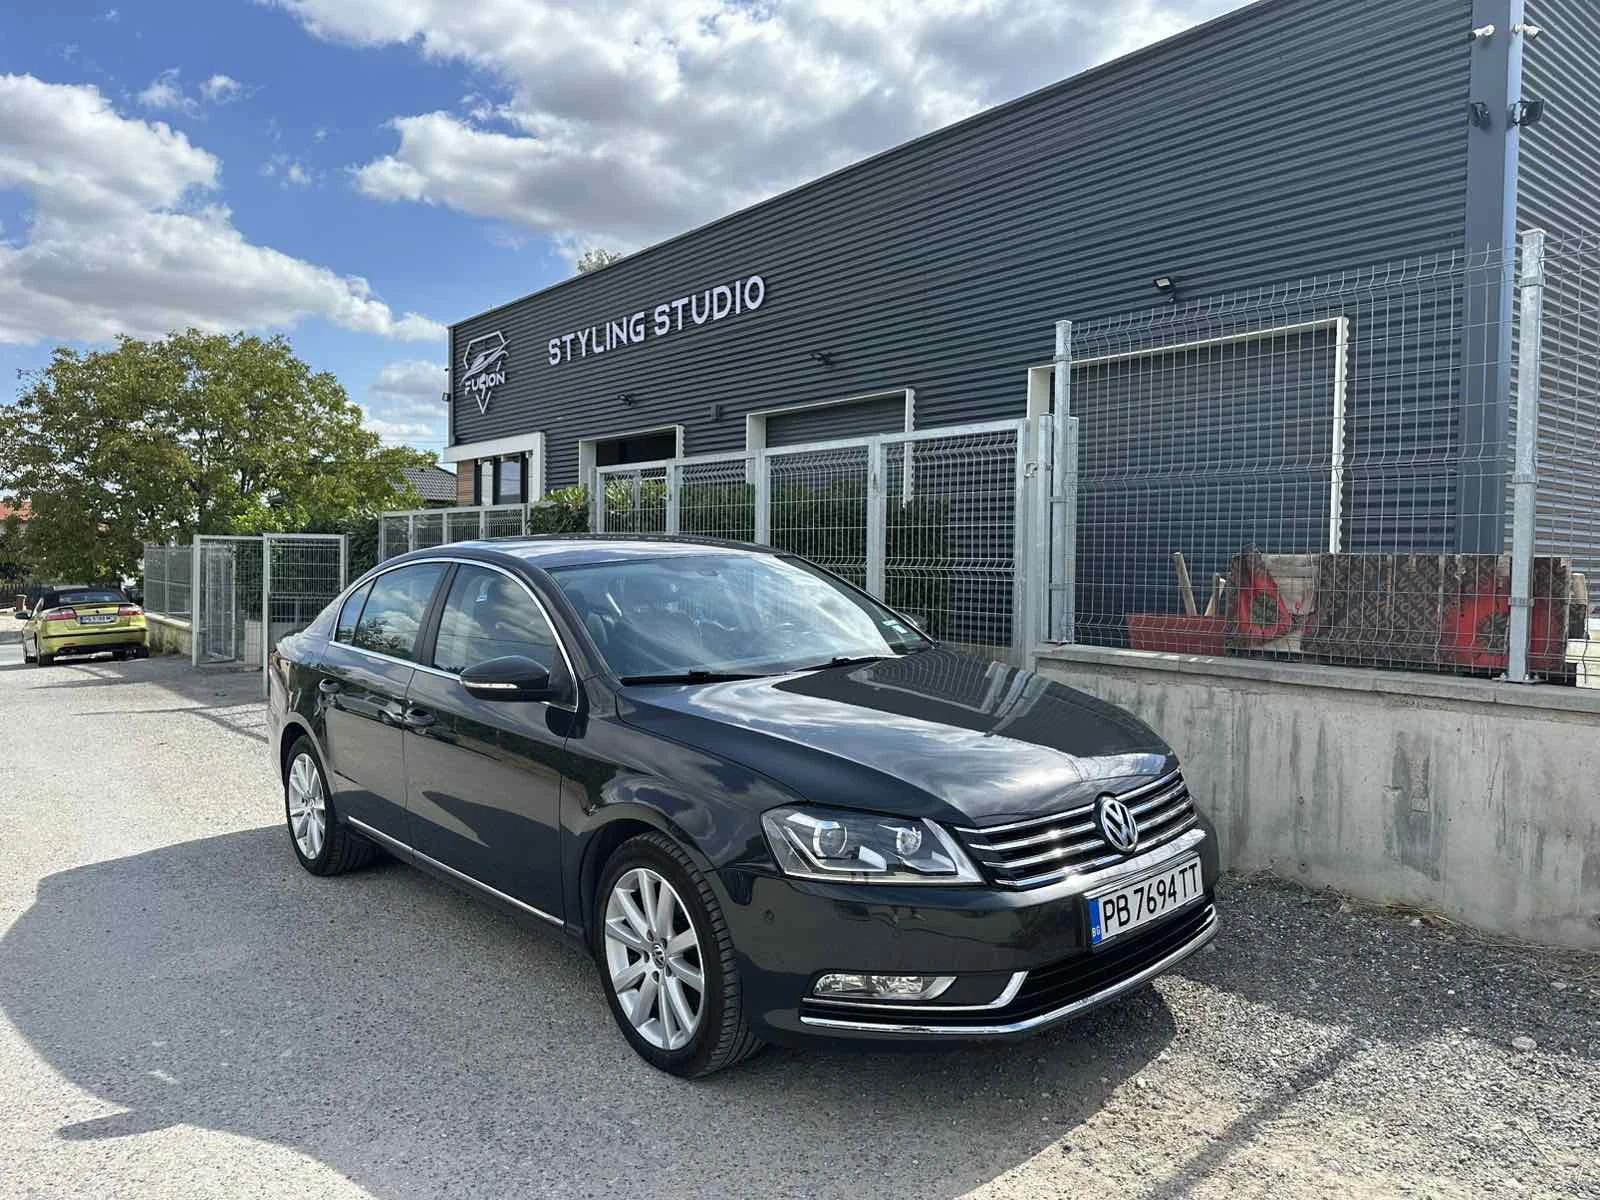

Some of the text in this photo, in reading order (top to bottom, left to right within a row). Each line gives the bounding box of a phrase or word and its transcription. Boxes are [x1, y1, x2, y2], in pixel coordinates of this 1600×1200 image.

[549, 275, 765, 365] STYLING STUDIO
[464, 371, 505, 397] FUSION
[1133, 873, 1177, 921] 7694
